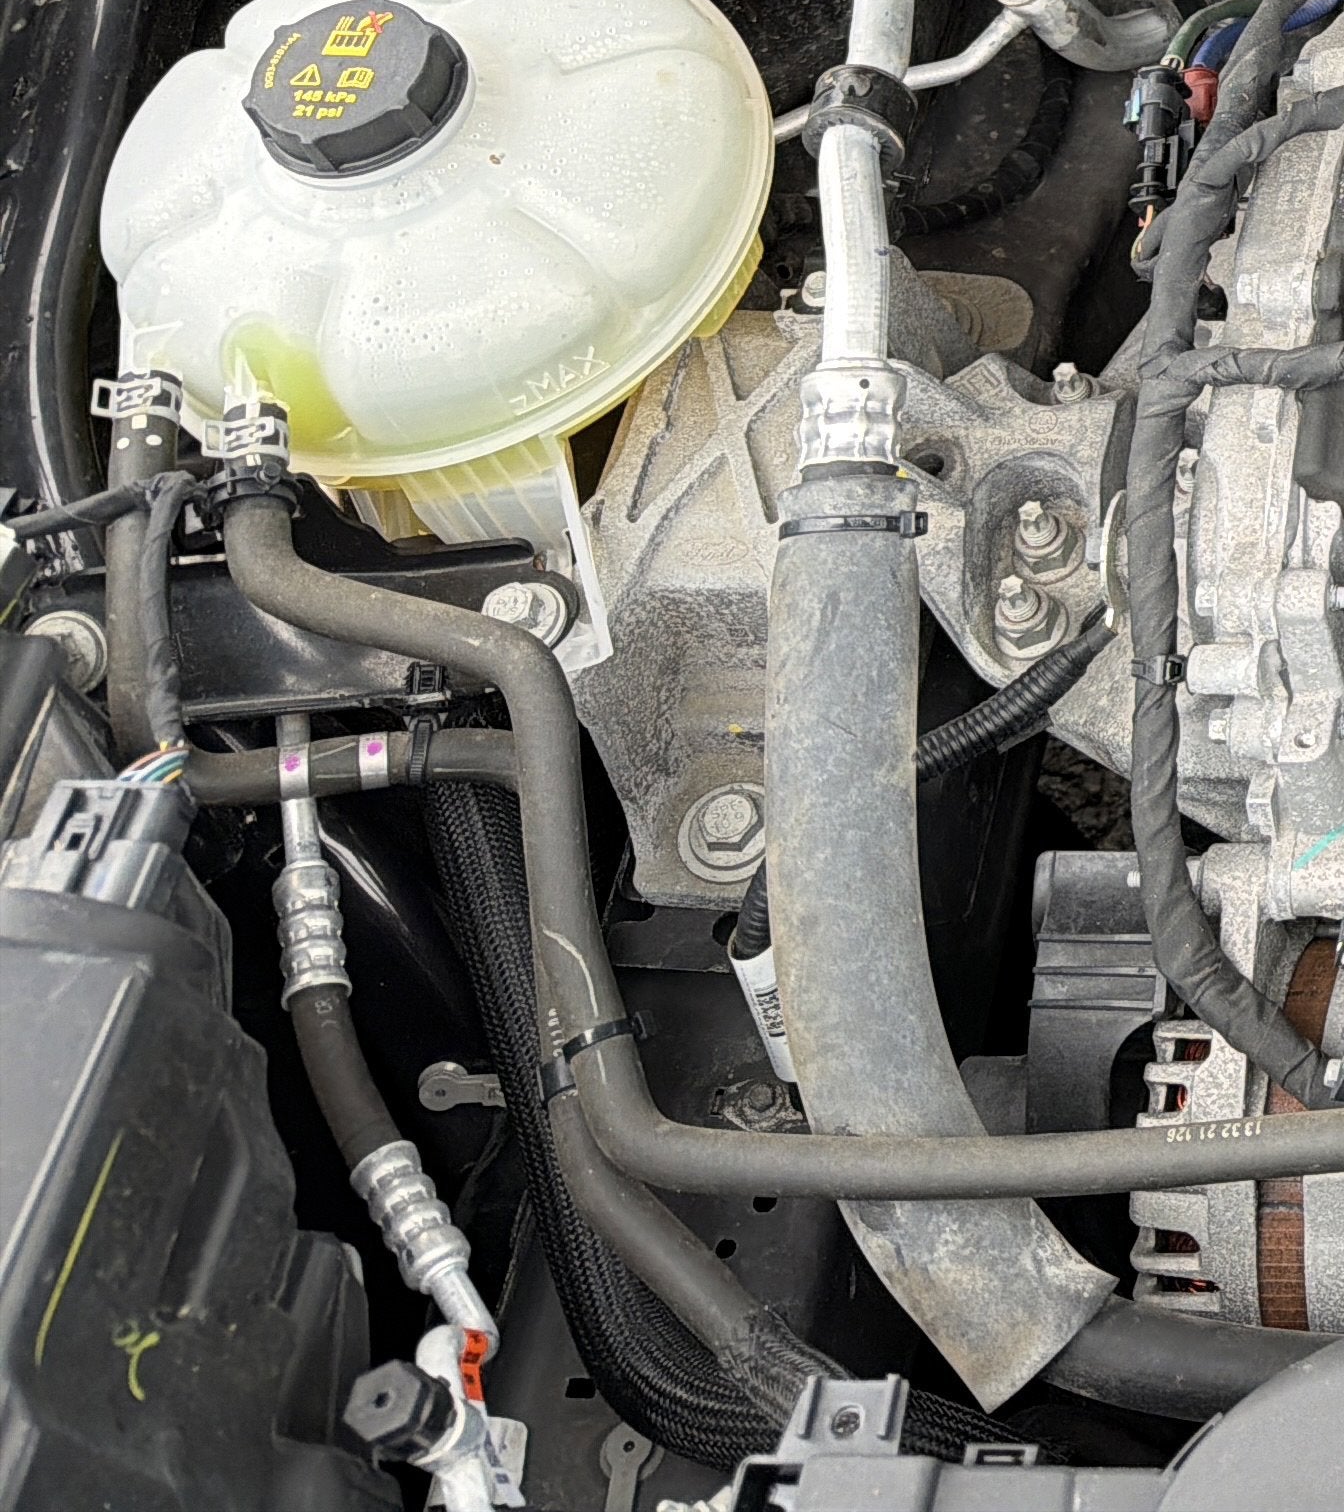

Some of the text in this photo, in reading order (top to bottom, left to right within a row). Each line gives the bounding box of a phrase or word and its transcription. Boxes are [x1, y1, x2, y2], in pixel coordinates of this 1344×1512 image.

[294, 90, 357, 104] 145 kPa
[292, 106, 343, 120] 21 psi
[1166, 1127, 1191, 1142] 126
